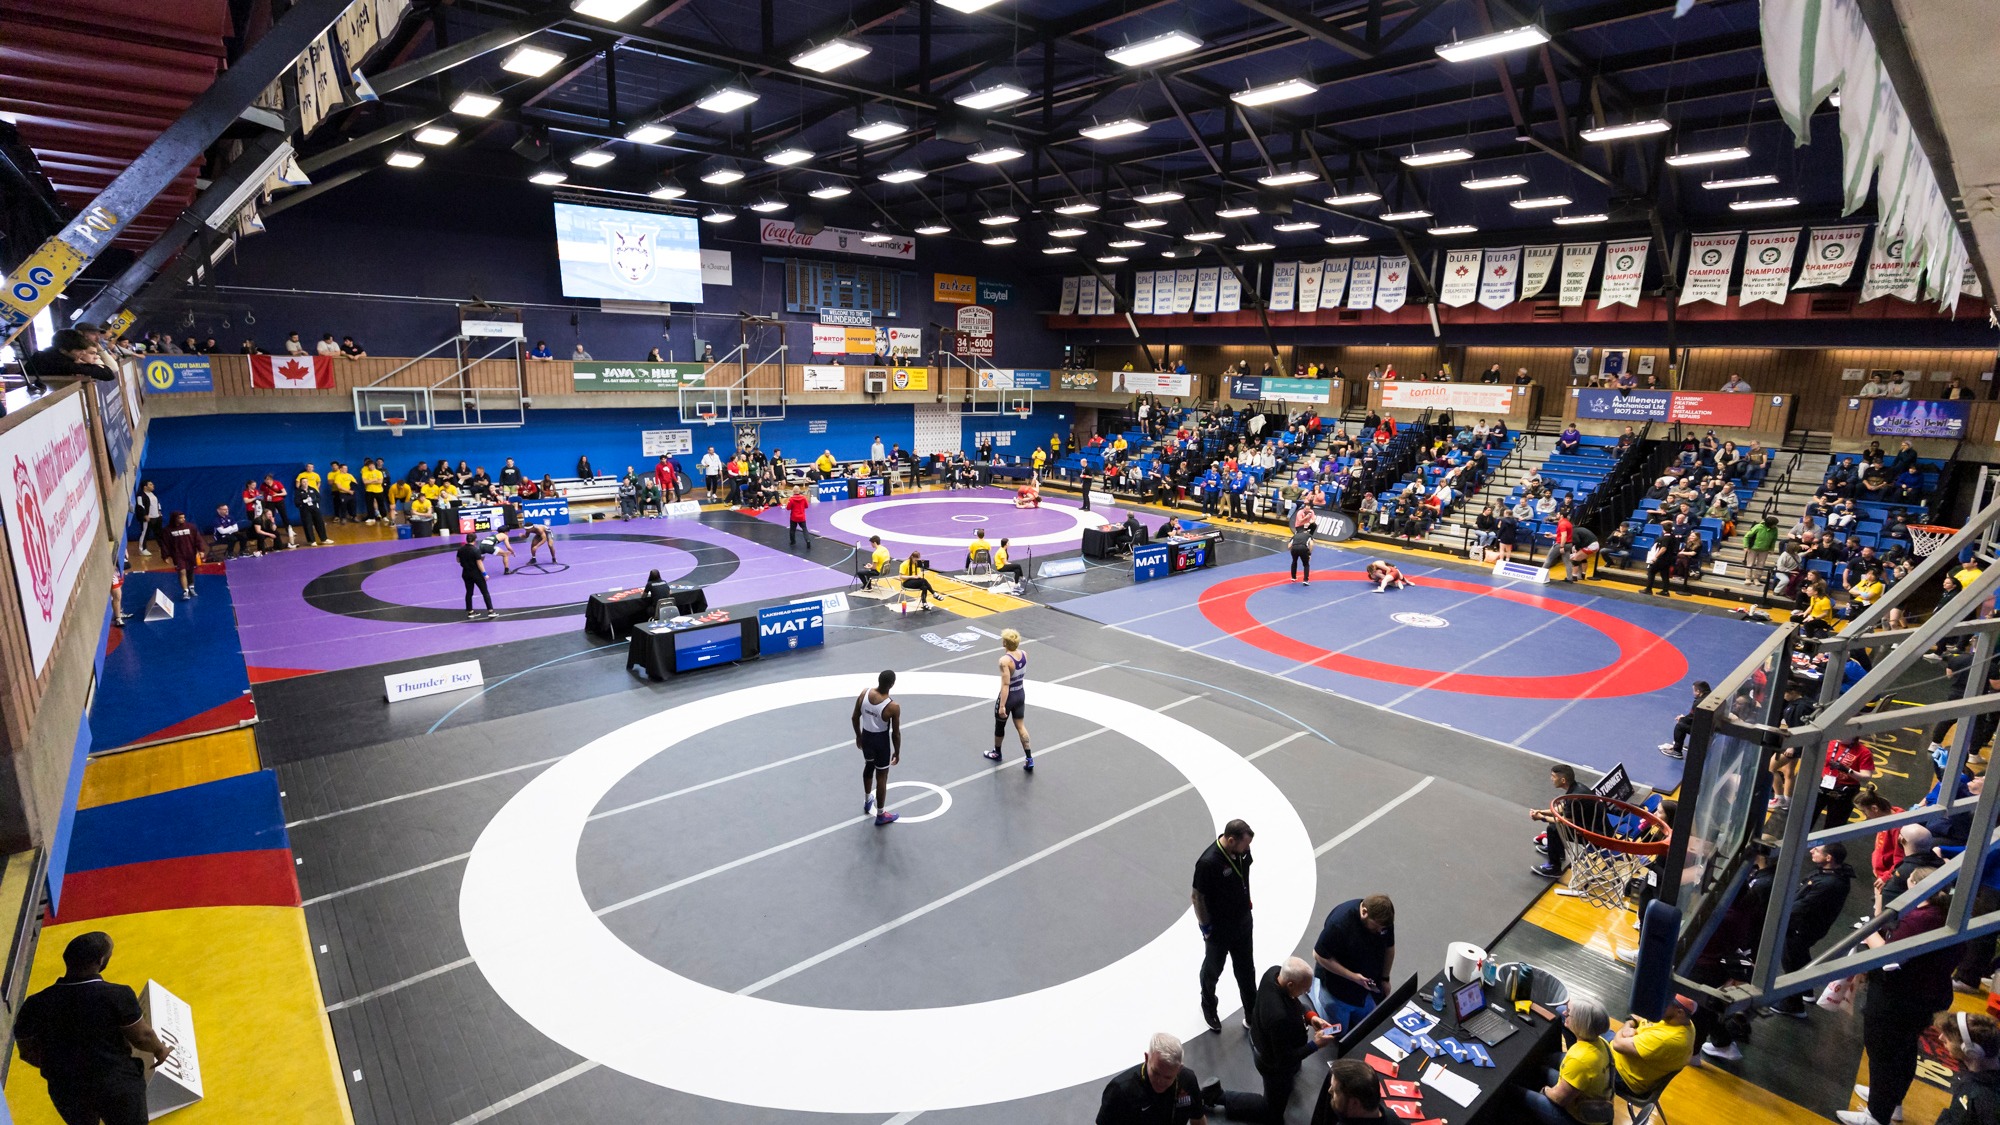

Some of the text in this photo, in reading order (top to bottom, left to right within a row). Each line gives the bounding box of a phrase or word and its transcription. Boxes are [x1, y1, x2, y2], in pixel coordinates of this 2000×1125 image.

[1750, 236, 1796, 246] OUA/SUO
[1812, 232, 1861, 241] OUA/SUO
[1693, 239, 1736, 247] OUA/SUO
[1608, 245, 1646, 254] OUA/SUO
[1745, 267, 1791, 275] CHAMPIONS
[1805, 261, 1853, 271] CHAMPIONS
[1605, 272, 1642, 281] CHAMPIONS
[1688, 268, 1730, 276] CHAMPIONS
[983, 288, 1008, 302] tbaytel
[822, 314, 870, 324] THUNDERDOME
[957, 338, 993, 348] 34-6000
[602, 367, 678, 379] JAVA HUT
[1410, 386, 1446, 397] tomlin
[1613, 395, 1667, 404] A.Villeneuve
[1849, 398, 1859, 407] P
[819, 485, 841, 494] MAT
[859, 488, 864, 496] 5
[524, 507, 568, 518] MAT 3
[463, 521, 471, 531] 2
[475, 522, 490, 530] 2:54
[493, 518, 501, 528] 6
[1135, 554, 1167, 568] MAT 1
[1179, 558, 1184, 567] 0
[1198, 553, 1202, 563] 0
[762, 605, 820, 618] LAKEHEAD WRESTLING
[761, 615, 823, 637] MAT 2
[396, 672, 472, 693] Thunder Bay
[1600, 769, 1623, 796] TURNKEY
[1420, 1036, 1434, 1049] 4
[1444, 1040, 1463, 1054] 2
[1389, 1084, 1408, 1095] 4
[1391, 1104, 1411, 1114] 2
